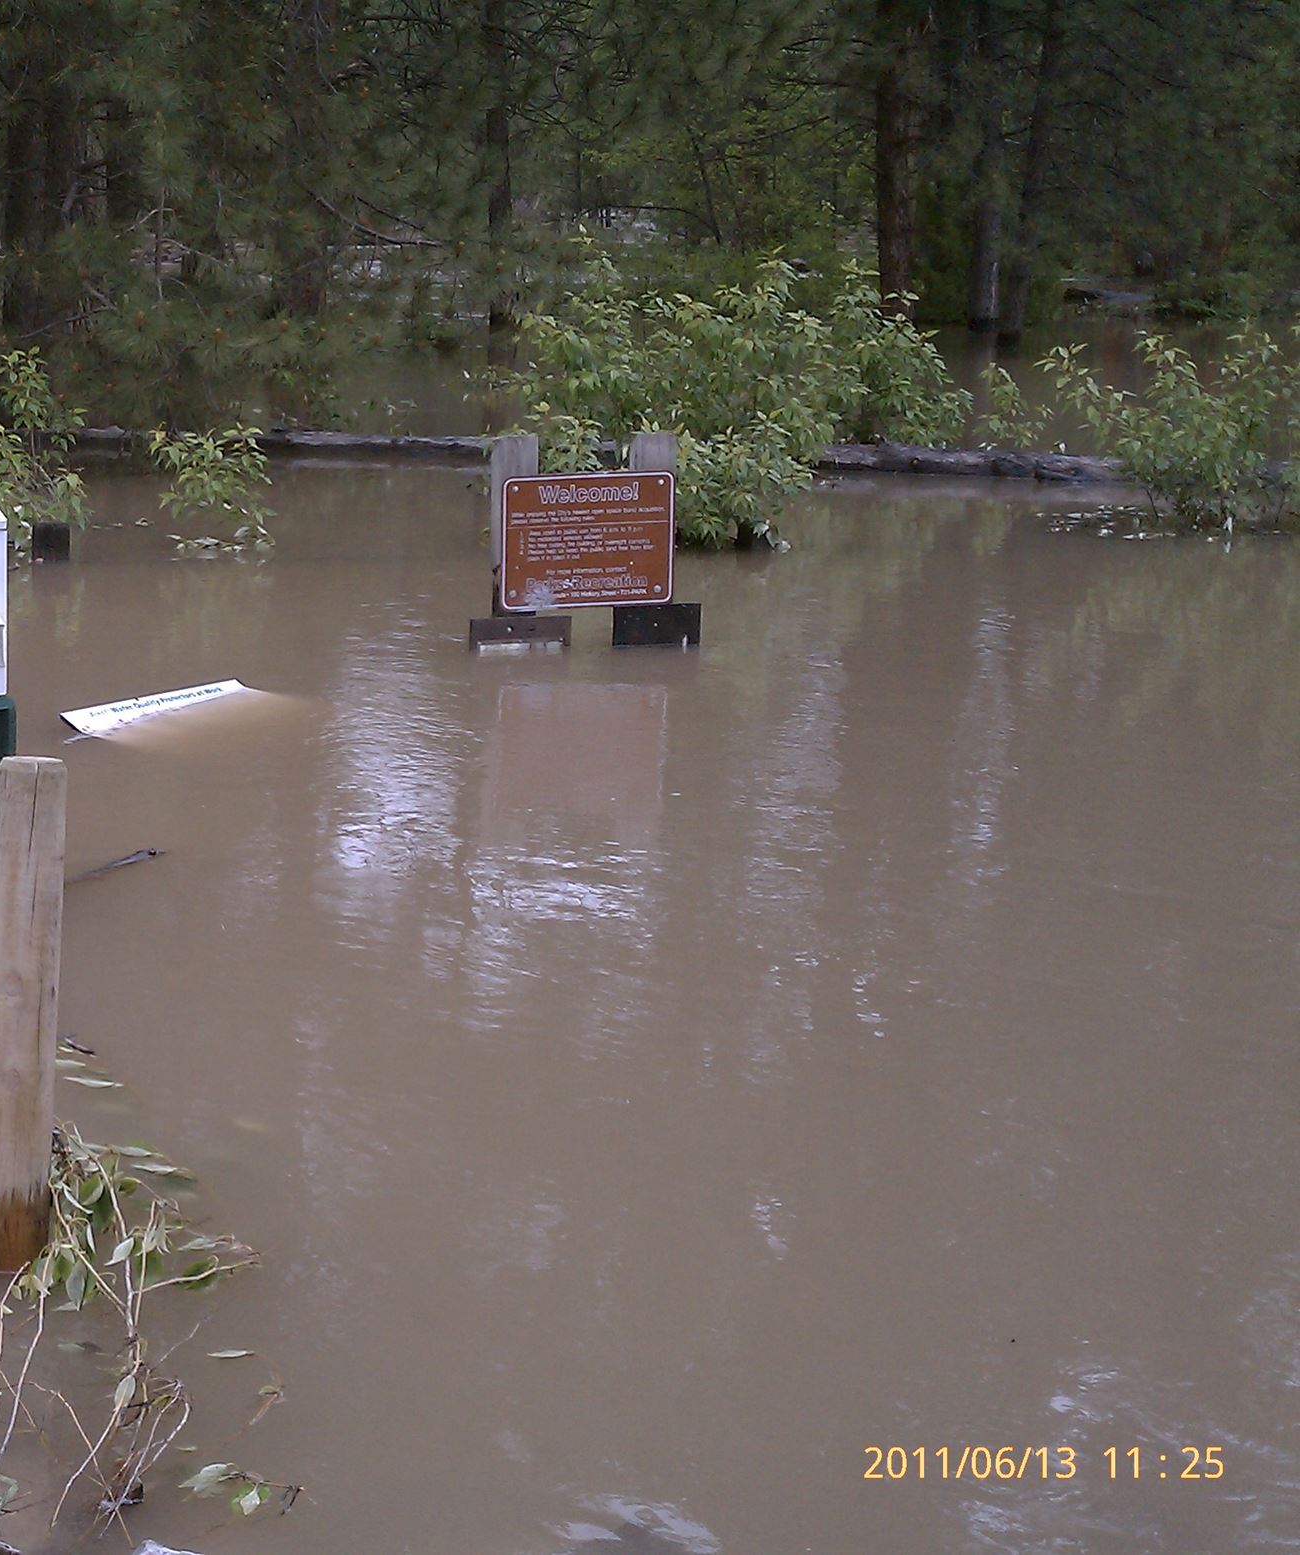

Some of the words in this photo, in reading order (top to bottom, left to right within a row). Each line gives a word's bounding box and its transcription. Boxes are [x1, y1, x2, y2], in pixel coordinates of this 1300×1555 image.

[538, 481, 639, 504] Welcome!
[572, 574, 648, 589] Recreation
[111, 704, 133, 713] Water
[133, 696, 160, 707] Quality
[203, 687, 224, 695] Work
